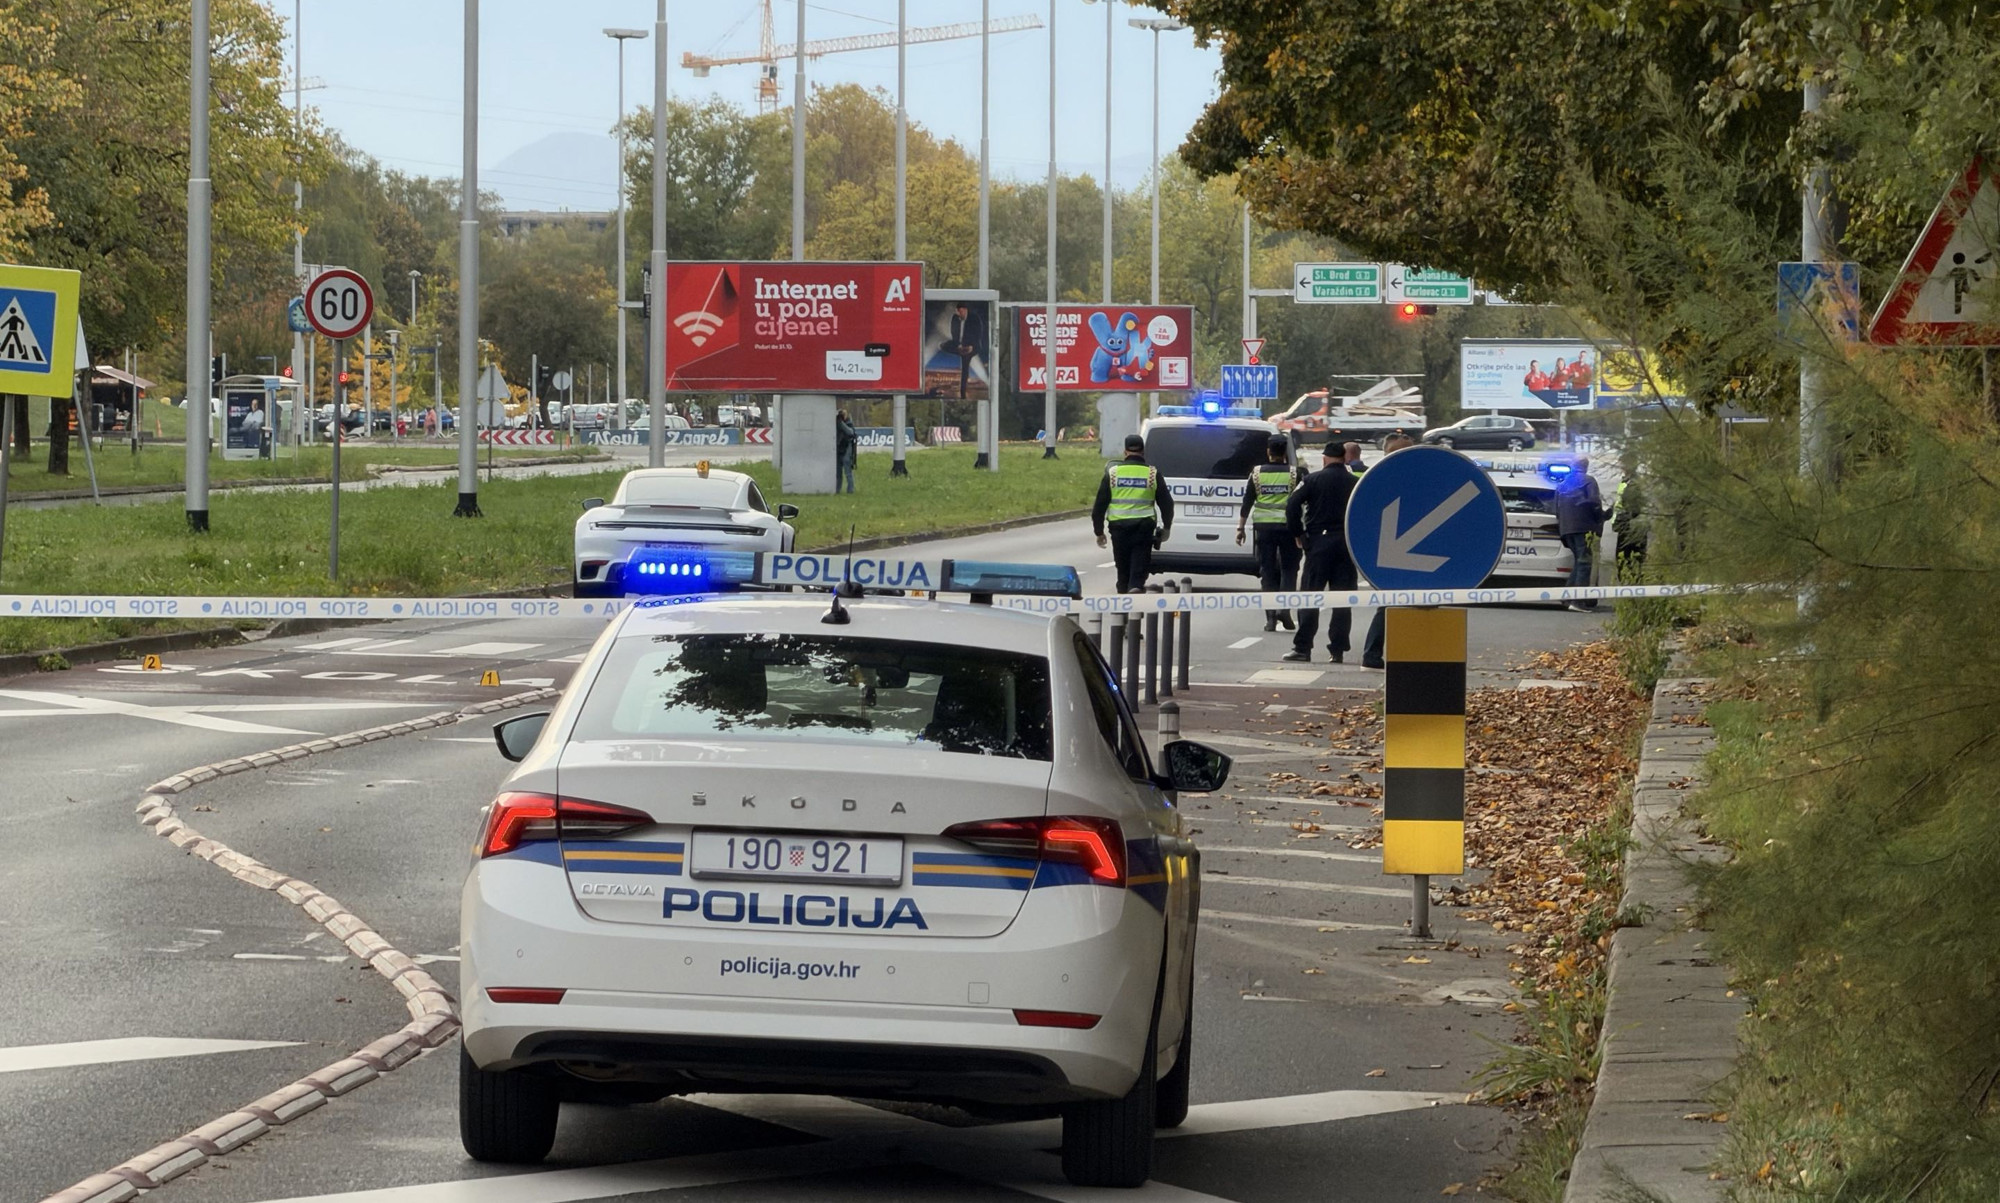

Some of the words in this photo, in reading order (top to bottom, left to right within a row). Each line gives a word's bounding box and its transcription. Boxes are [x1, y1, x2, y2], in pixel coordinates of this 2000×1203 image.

[1329, 270, 1350, 280] Brod
[754, 277, 858, 300] Internet
[884, 276, 911, 303] A1
[1314, 286, 1354, 296] Varaždin
[1405, 287, 1440, 297] Karlovac
[321, 288, 359, 321] 60
[755, 302, 770, 317] u
[778, 298, 835, 322] pola
[755, 316, 839, 341] cijene!
[1030, 324, 1078, 338] UŠEDE
[832, 363, 859, 374] 14,21
[1466, 363, 1494, 371] Otkrijte
[1495, 363, 1514, 371] priče
[1027, 367, 1079, 385] XRA
[588, 431, 642, 445] Novi
[666, 430, 730, 446] Zagreb
[699, 461, 706, 471] 5
[772, 554, 931, 586] POLICIJA
[147, 656, 156, 669] 2
[486, 672, 494, 684] 1
[692, 791, 908, 815] ŠKODA
[727, 837, 782, 871] 190
[811, 840, 869, 874] 921
[581, 883, 656, 897] OCTAVIA
[663, 887, 929, 930] POLICIJA
[720, 957, 861, 980] policija.gov.hr
